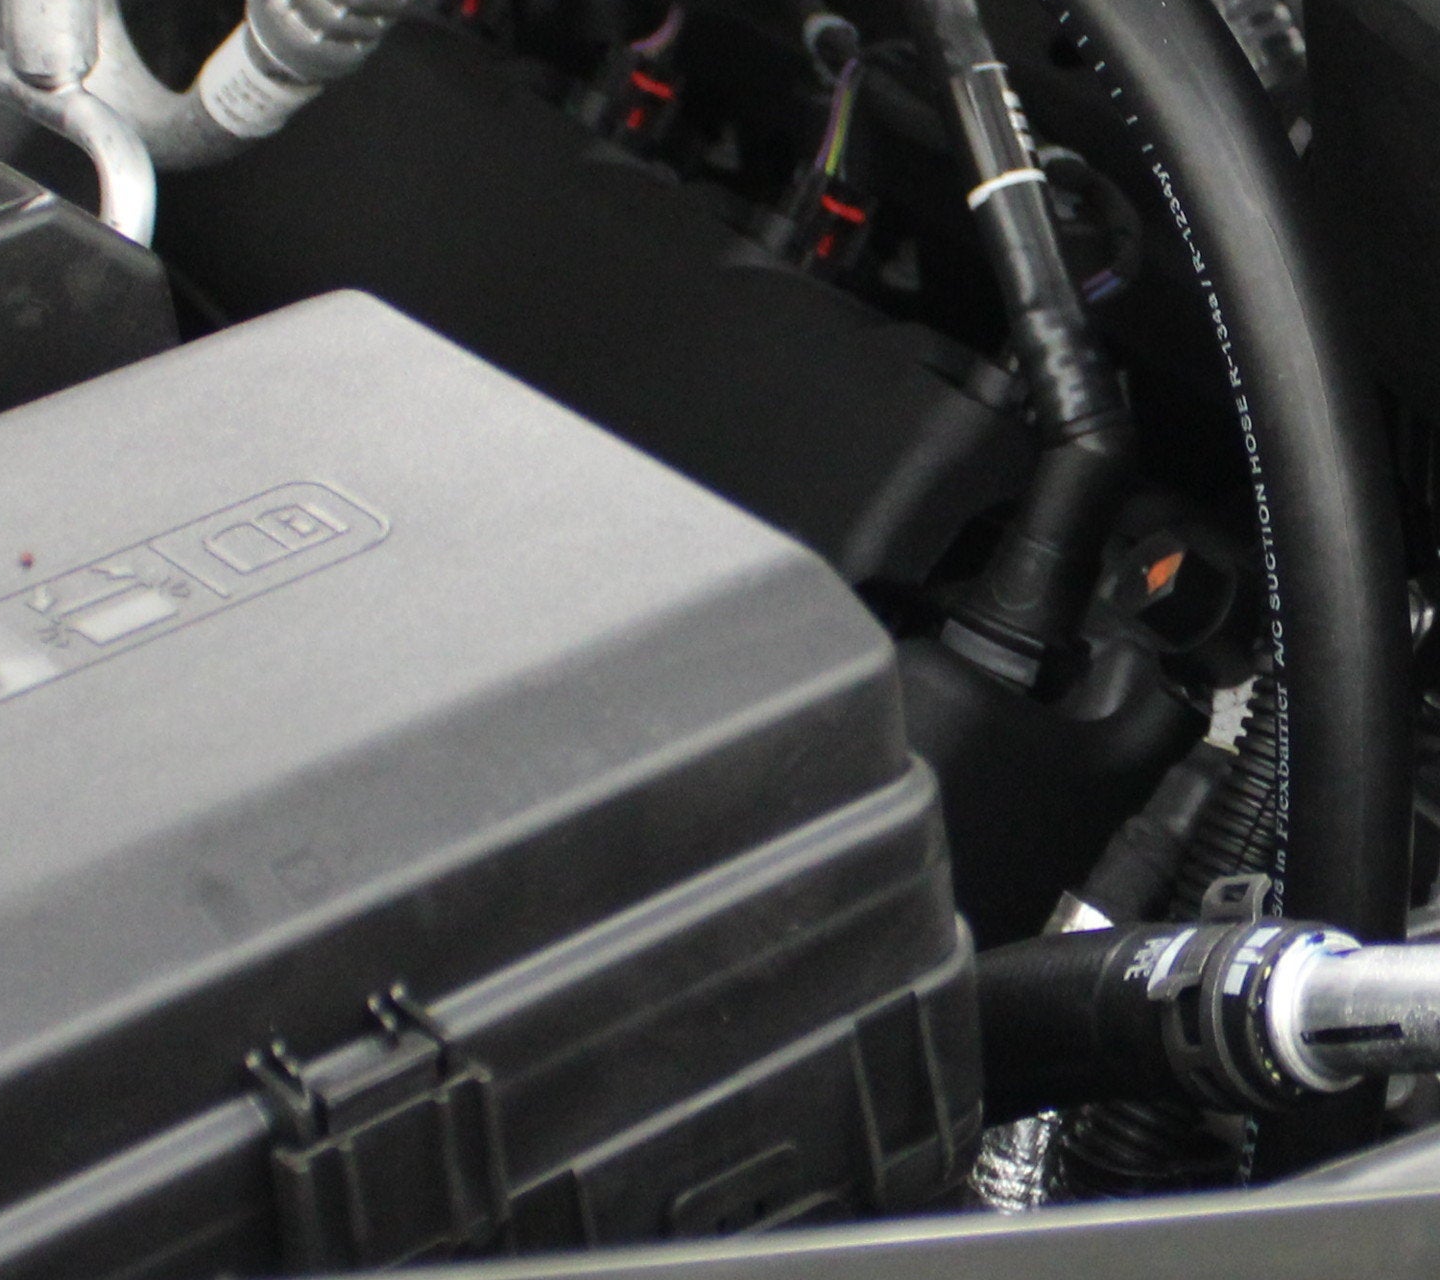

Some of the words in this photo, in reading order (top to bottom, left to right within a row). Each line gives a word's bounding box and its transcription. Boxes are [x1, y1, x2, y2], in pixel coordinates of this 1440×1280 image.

[1152, 162, 1206, 273] R-1234yf
[1209, 292, 1242, 388] R-134a
[1235, 394, 1262, 475] HOSE
[1255, 483, 1281, 611] SUCTION
[1271, 620, 1284, 667] A/C
[1276, 682, 1290, 842] Flexbarrier
[1275, 849, 1286, 873] in
